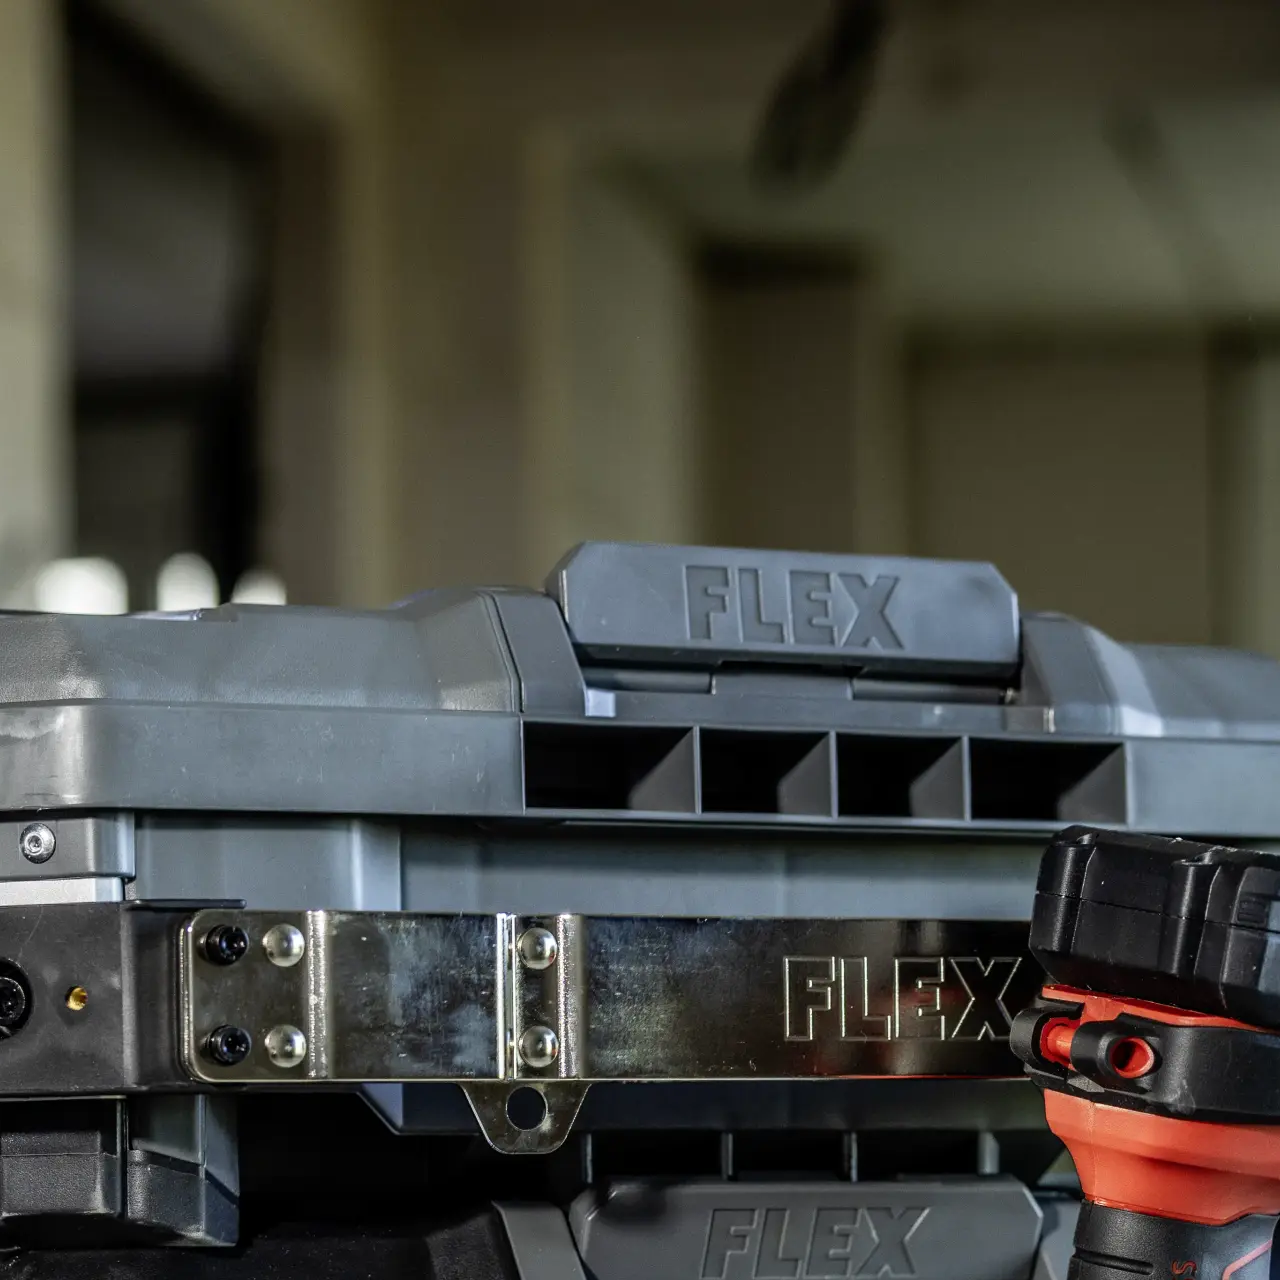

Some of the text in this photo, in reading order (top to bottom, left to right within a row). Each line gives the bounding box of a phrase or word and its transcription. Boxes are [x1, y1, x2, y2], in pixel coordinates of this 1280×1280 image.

[681, 564, 905, 650] FLEX
[783, 956, 1022, 1042] FLEX
[699, 1206, 933, 1280] FLEX
